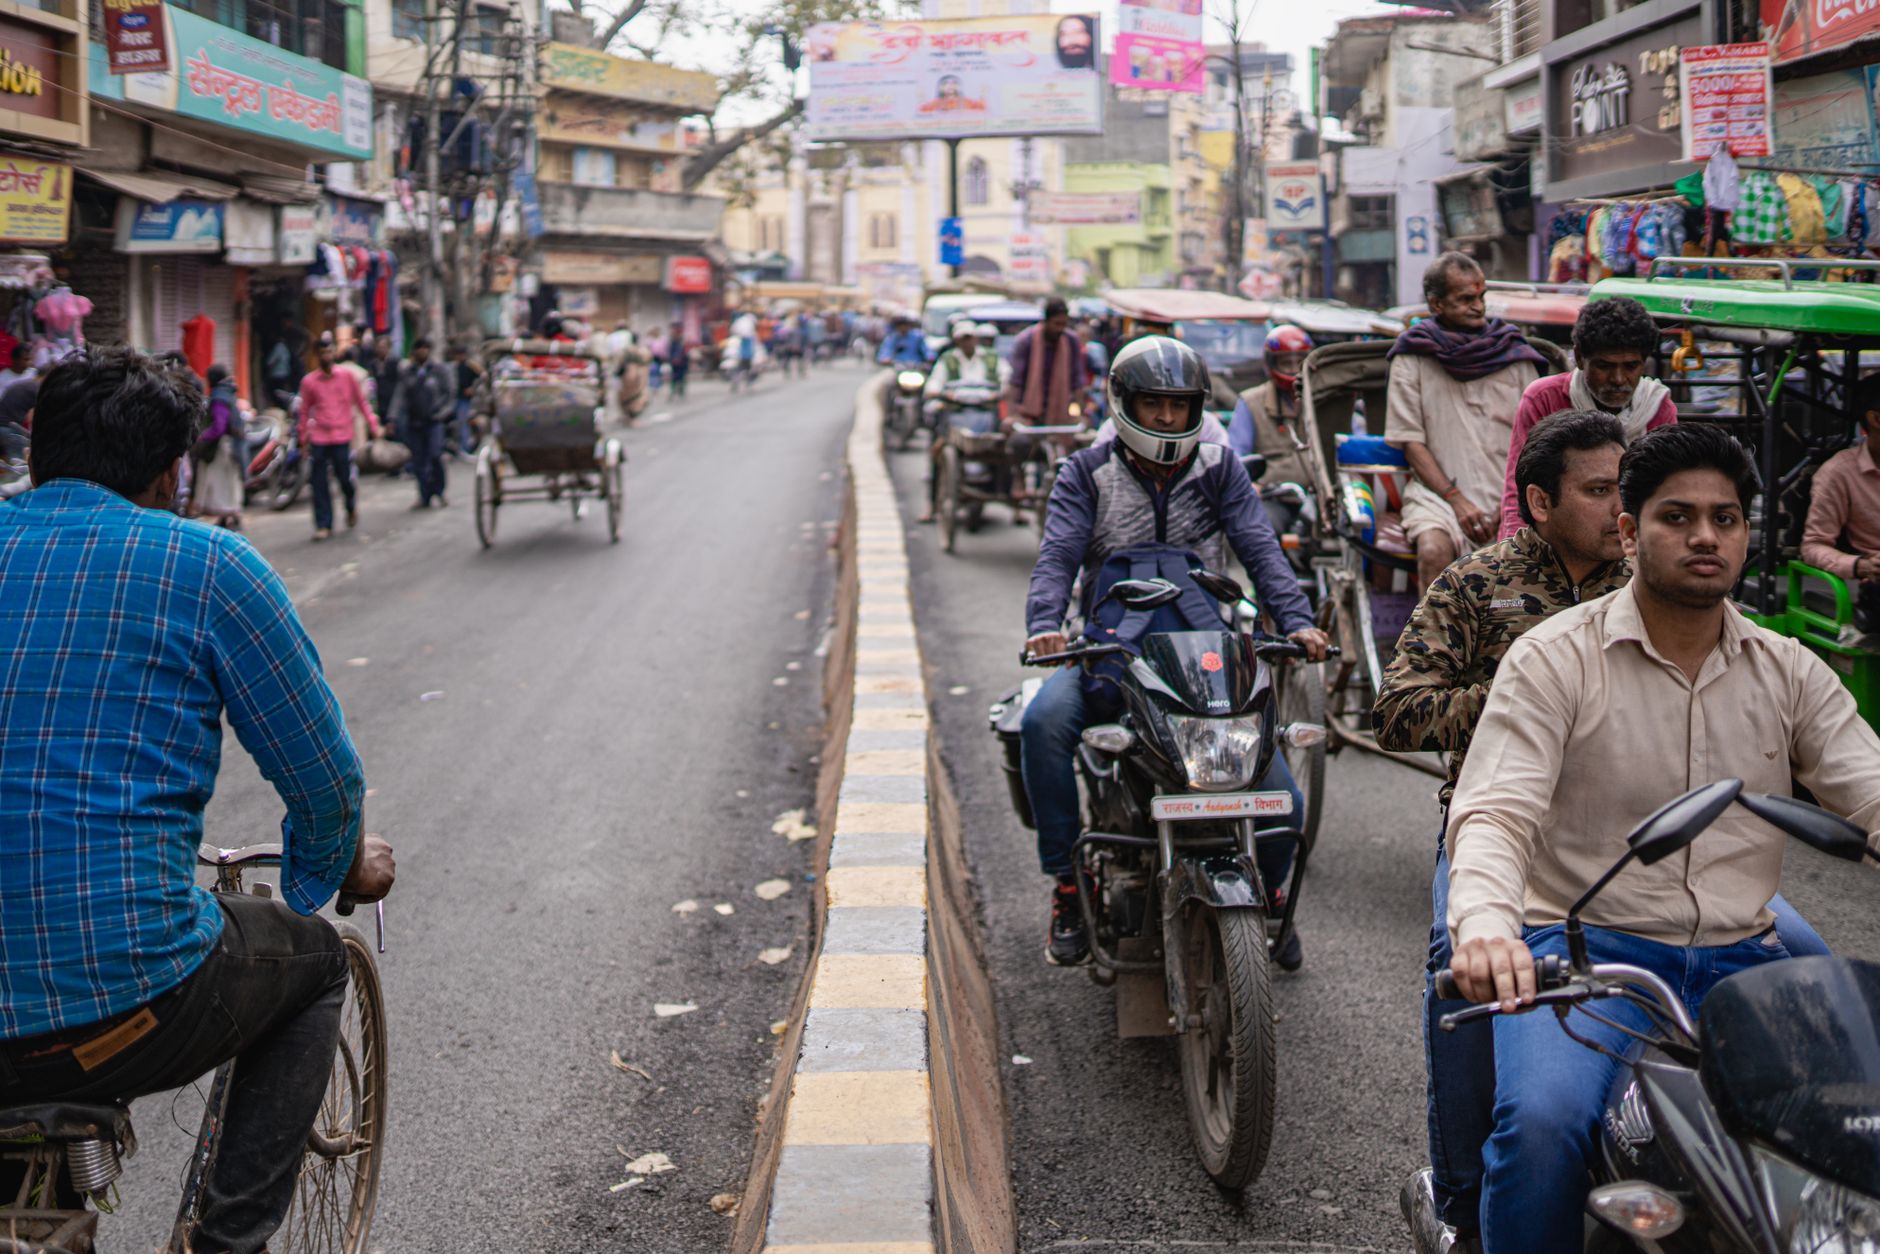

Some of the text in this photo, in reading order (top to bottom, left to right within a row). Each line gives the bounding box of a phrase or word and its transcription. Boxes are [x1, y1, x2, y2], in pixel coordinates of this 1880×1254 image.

[1207, 700, 1231, 708] Hero
[1162, 802, 1193, 814] राजस्व
[1254, 797, 1283, 812] विभाग
